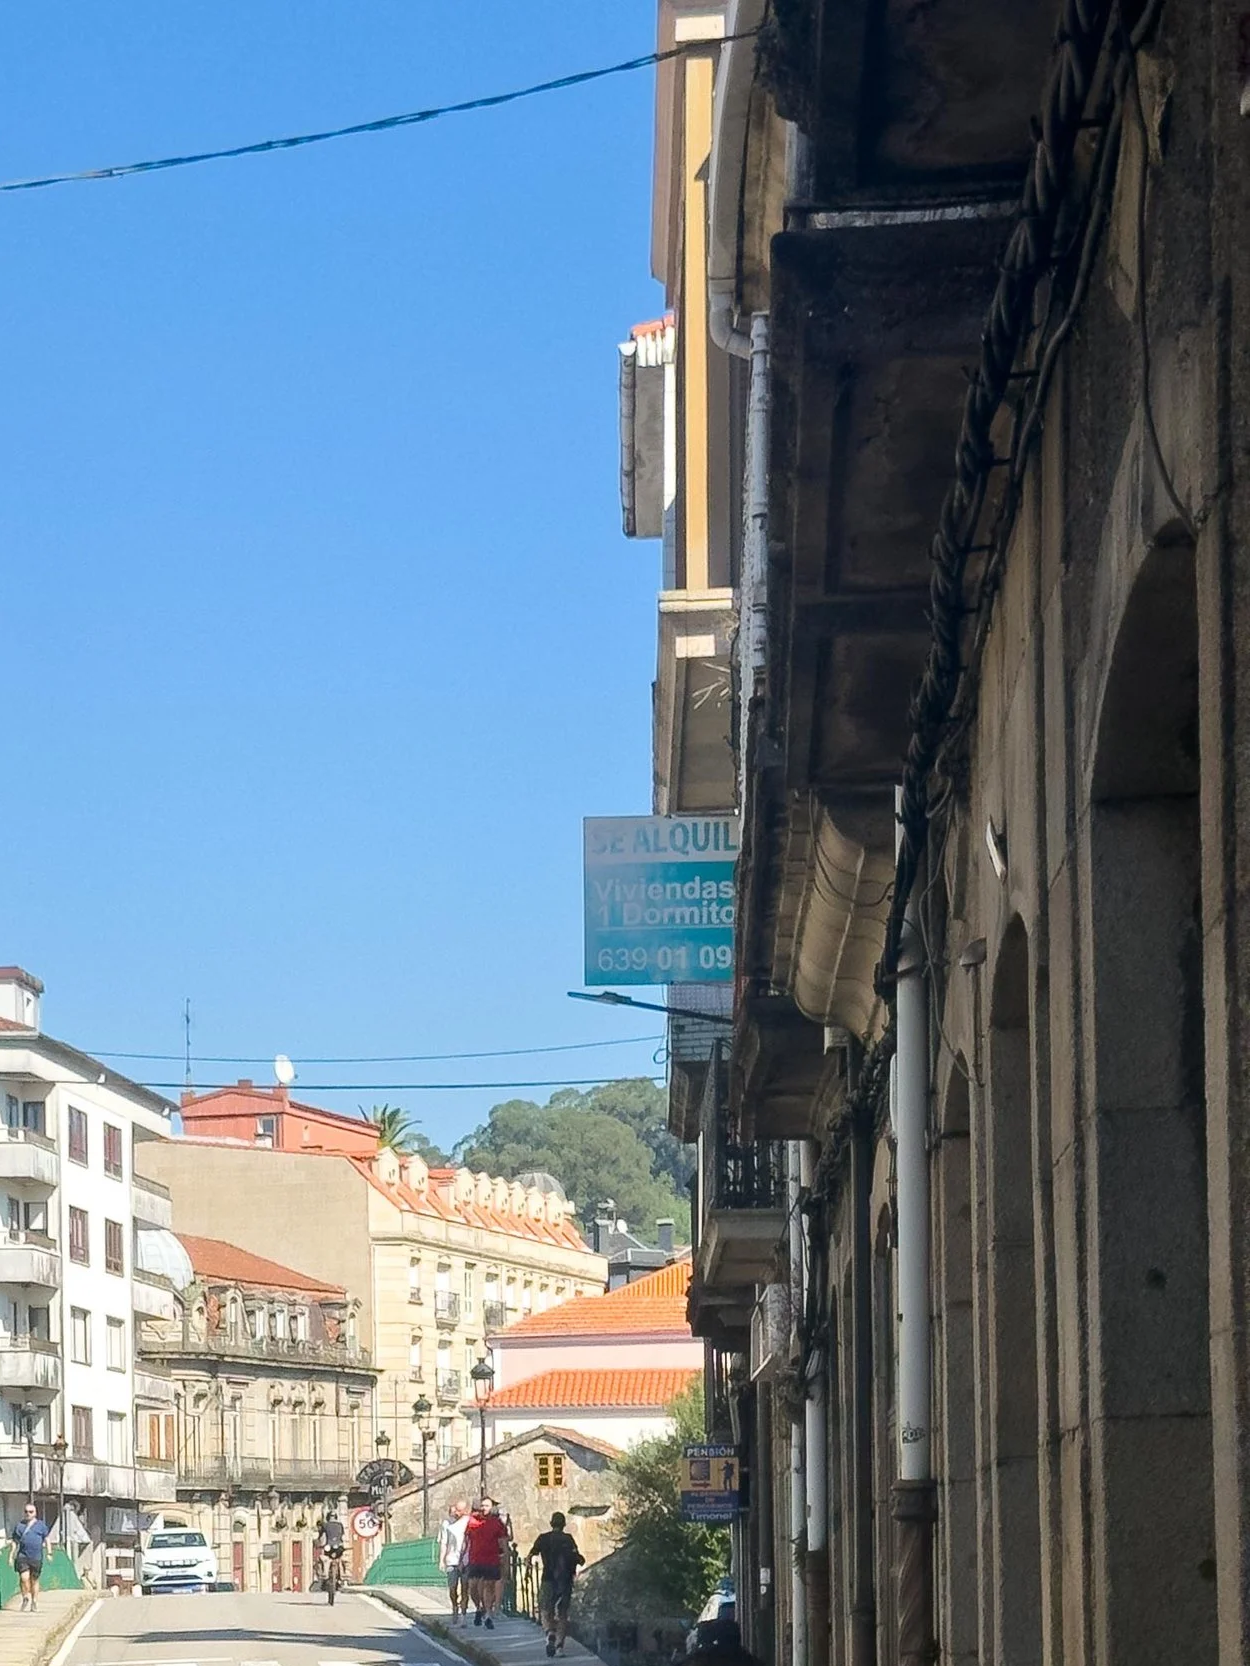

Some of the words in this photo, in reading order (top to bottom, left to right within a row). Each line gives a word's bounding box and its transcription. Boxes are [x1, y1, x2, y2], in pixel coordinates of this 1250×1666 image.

[592, 828, 625, 854] SE
[632, 821, 740, 856] ALQUIL
[594, 876, 735, 901] Viviendas
[597, 904, 609, 926] 1
[598, 947, 647, 971] 639
[658, 946, 687, 970] 01
[700, 945, 732, 969] 09
[359, 1519, 375, 1529] 50
